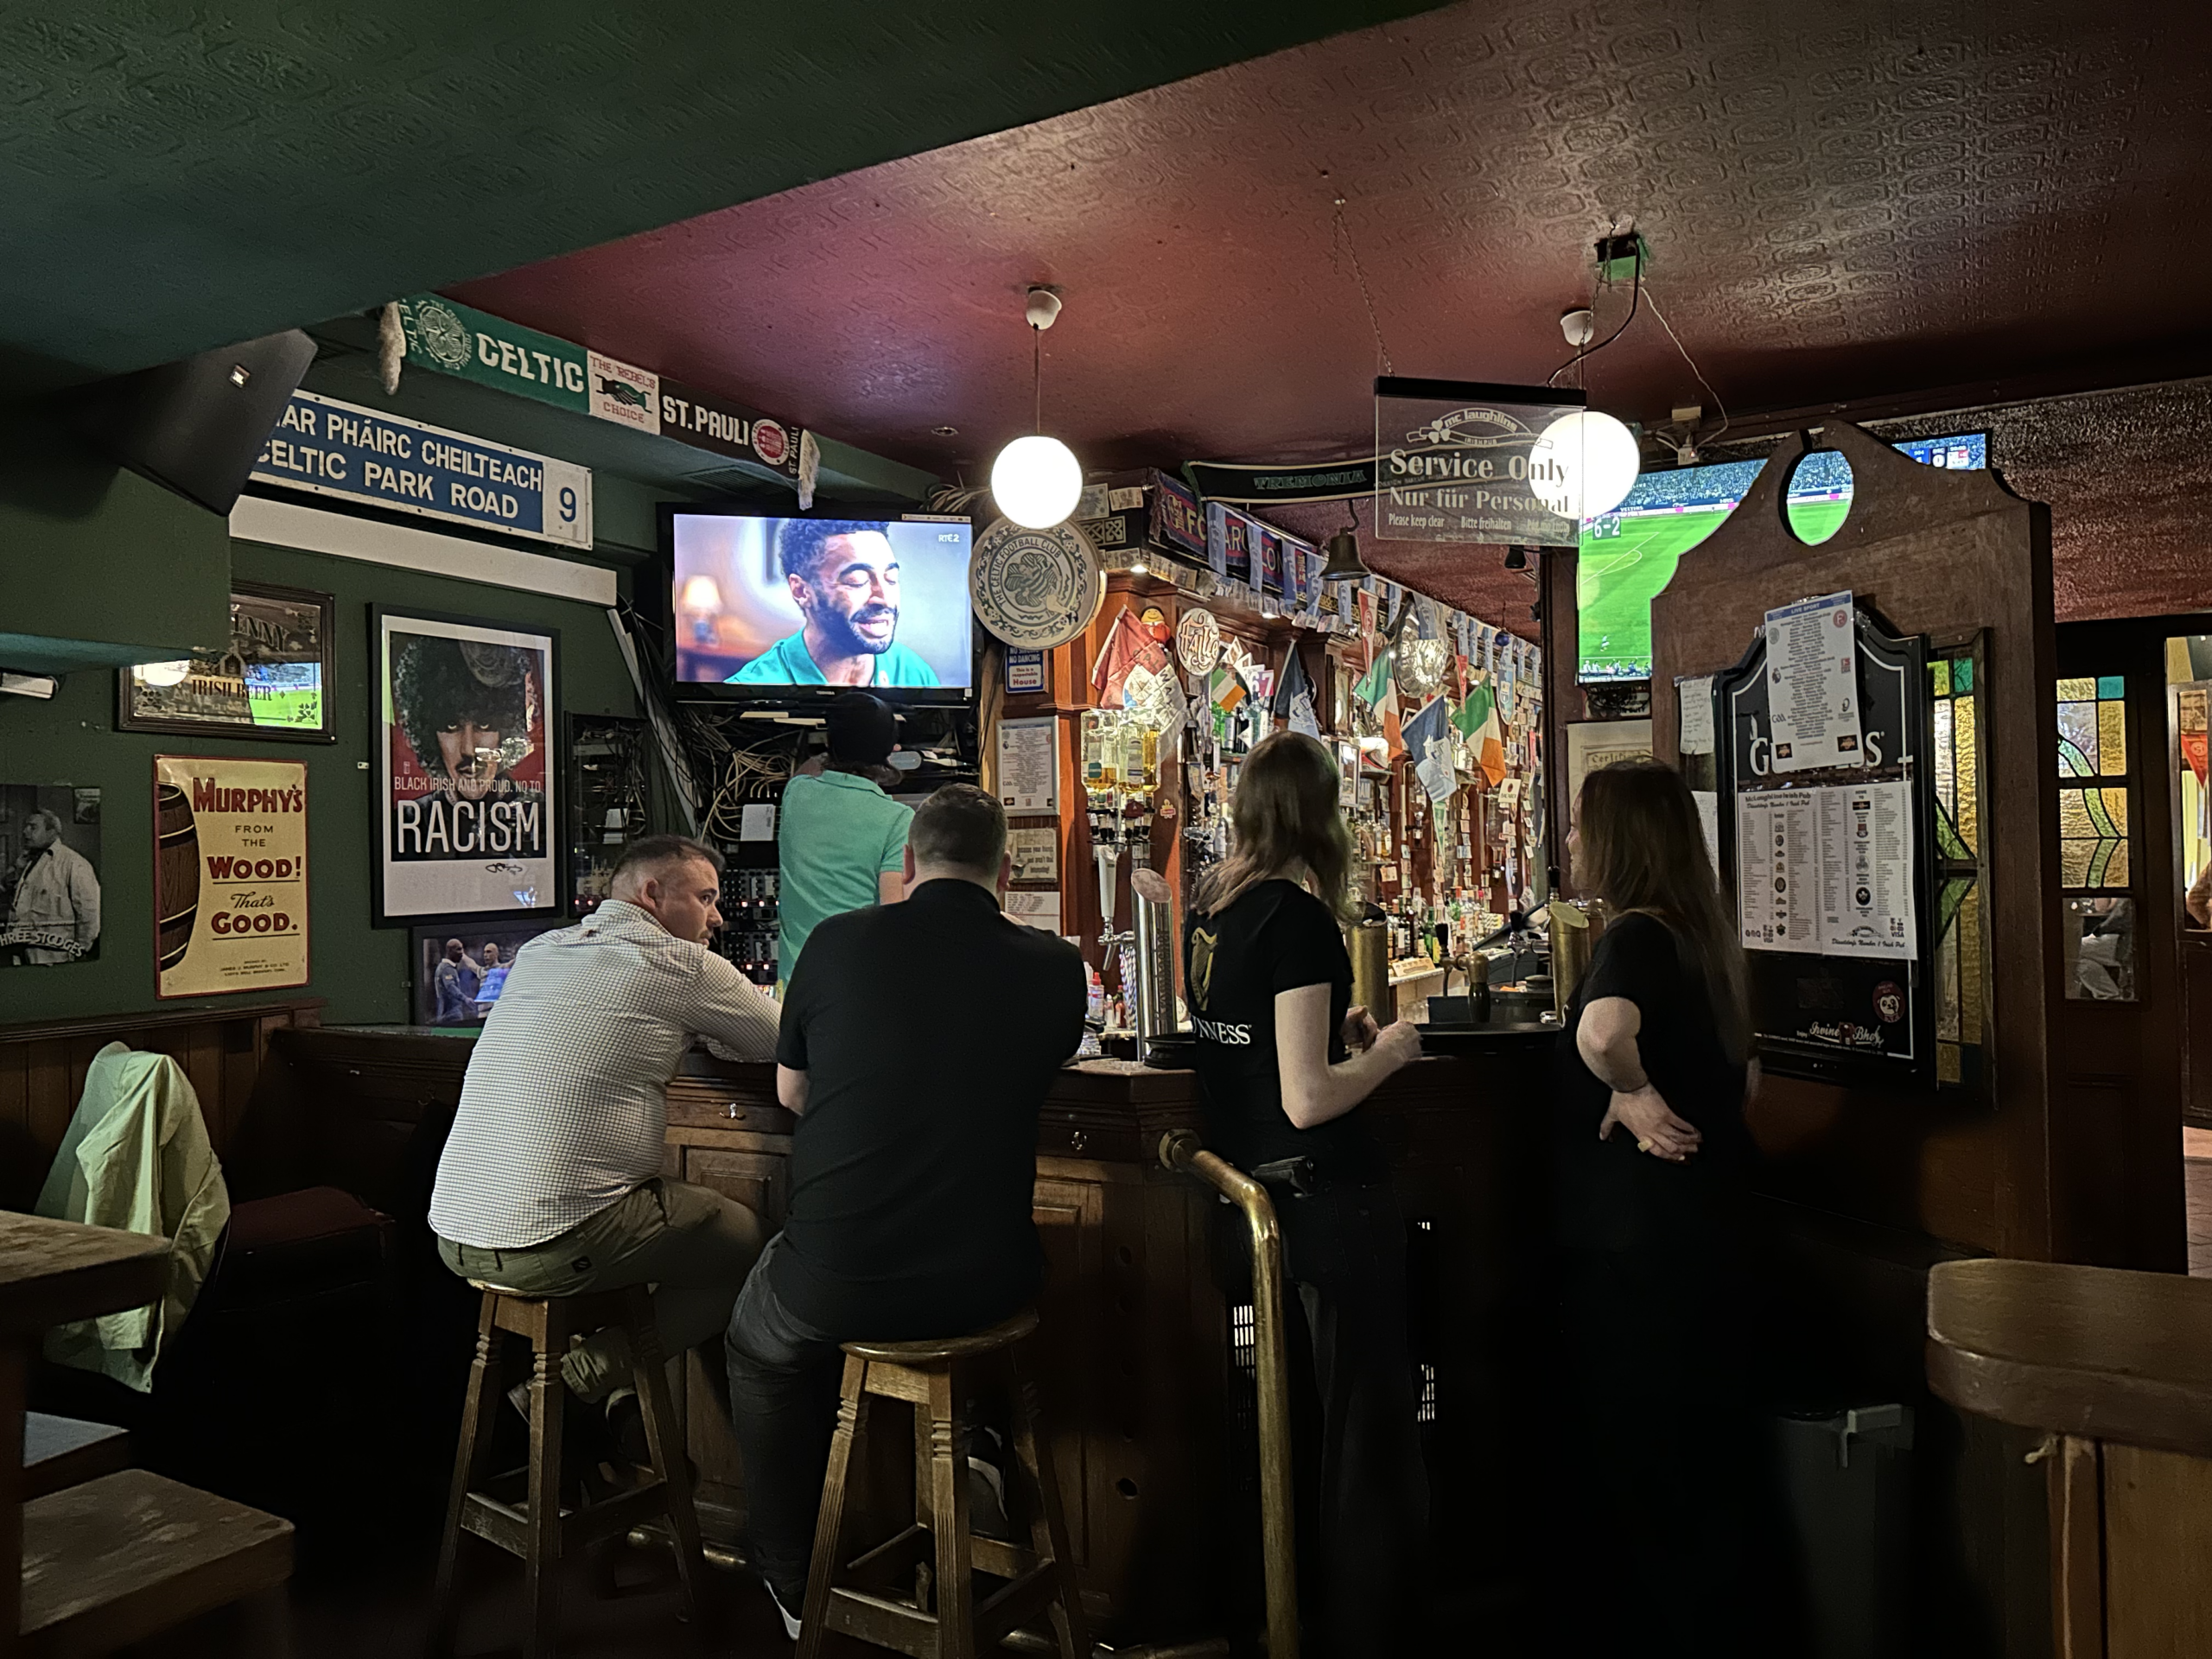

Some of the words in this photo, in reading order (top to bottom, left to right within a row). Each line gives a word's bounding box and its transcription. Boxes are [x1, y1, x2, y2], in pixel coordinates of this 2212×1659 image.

[399, 299, 423, 354] ELTIC
[476, 333, 584, 392] CELTIC
[589, 355, 613, 373] THE
[603, 402, 645, 423] CHOICE
[276, 404, 316, 435] AR
[327, 413, 412, 460] PHÁIRC
[422, 432, 543, 493] CHEILTEACH
[790, 426, 800, 459] PAULI
[1389, 449, 1494, 479] Service
[1509, 455, 1569, 487] Only
[365, 461, 435, 501] PARK
[450, 484, 519, 518] ROAD
[1254, 469, 1367, 490] TREMONIA
[558, 486, 577, 522] 9
[1389, 486, 1429, 507] Nur
[1437, 489, 1468, 509] für
[1477, 490, 1569, 512] Personal
[1389, 513, 1409, 526] Please
[1411, 514, 1427, 529] keep
[1428, 515, 1446, 528] clear
[1461, 516, 1478, 529] Bitte
[1479, 517, 1512, 531] freihalten
[1594, 517, 1620, 537] 6-2
[953, 533, 960, 543] 2
[999, 537, 1039, 559] FOOTBALL
[1041, 540, 1061, 558] CLUB
[991, 558, 1003, 588] CELTIC
[994, 588, 1007, 607] THE
[1803, 602, 1820, 612] SPORT
[231, 613, 290, 654] ENNY
[1018, 654, 1040, 663] DANCING
[192, 678, 232, 697] IRISH
[237, 683, 273, 701] BEER
[193, 778, 303, 813] MURPHY'S
[394, 777, 427, 791] BLACK
[429, 778, 455, 791] IRISH
[458, 779, 477, 791] AND
[480, 780, 513, 793] PROUD.
[529, 780, 541, 793] TO
[235, 825, 274, 834] FROM
[397, 800, 539, 853] RACISM
[242, 839, 266, 848] THE
[207, 856, 302, 880] WOOD!
[231, 891, 275, 909] That's
[211, 912, 299, 934] GOOD.
[0, 931, 32, 946] HREE
[33, 931, 86, 957] STOOGES
[1192, 1014, 1250, 1046] INNESS
